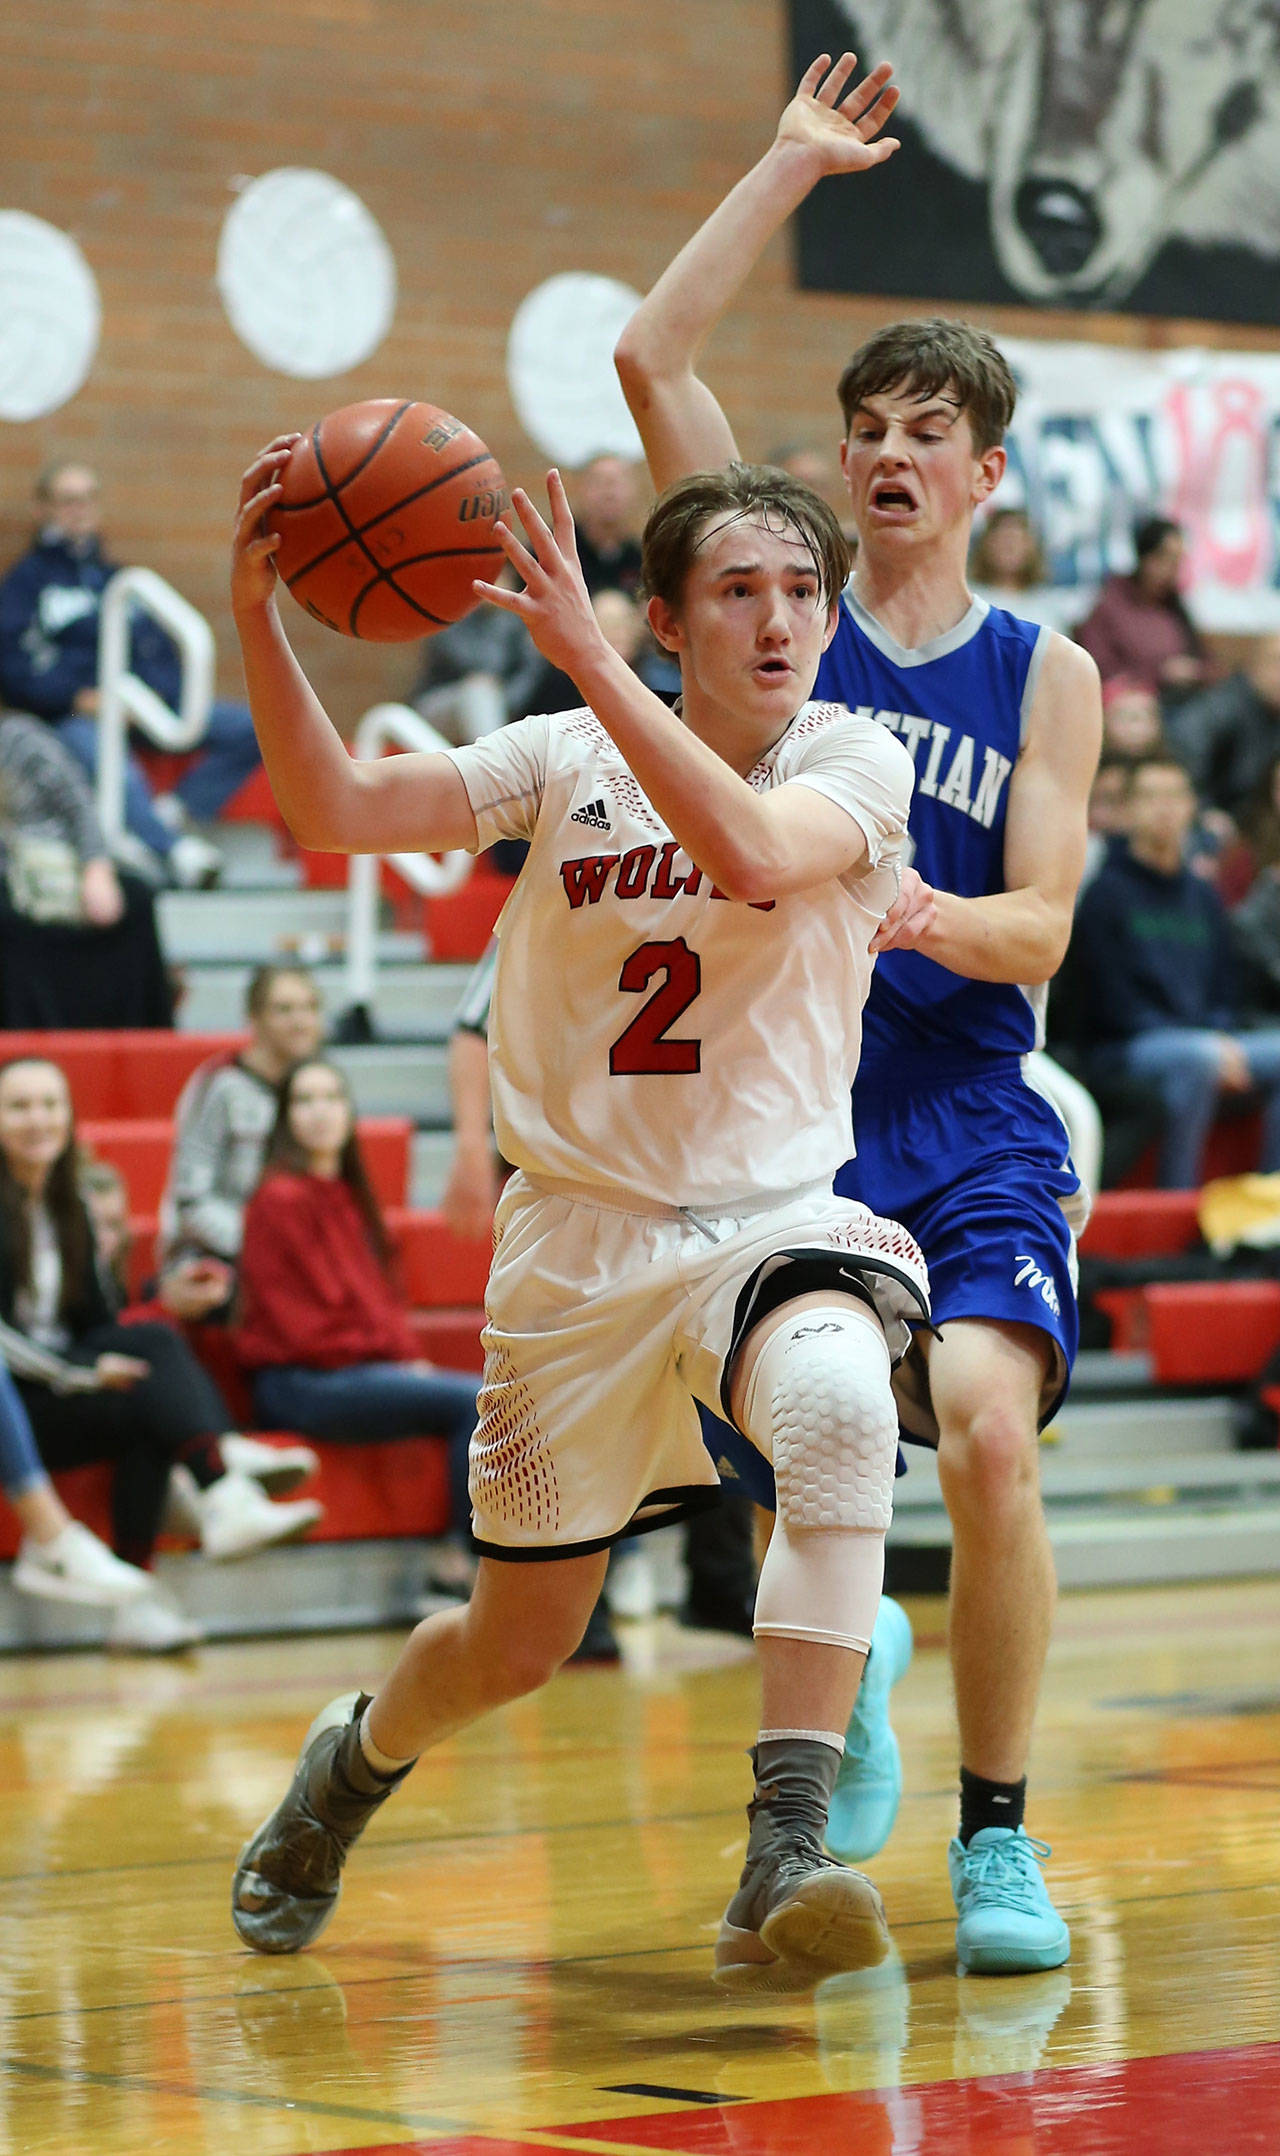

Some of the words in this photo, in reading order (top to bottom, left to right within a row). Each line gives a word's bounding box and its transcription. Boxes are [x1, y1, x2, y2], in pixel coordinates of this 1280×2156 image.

[571, 812, 612, 831] adidas
[560, 842, 776, 912] WOL
[609, 936, 701, 1076] 2
